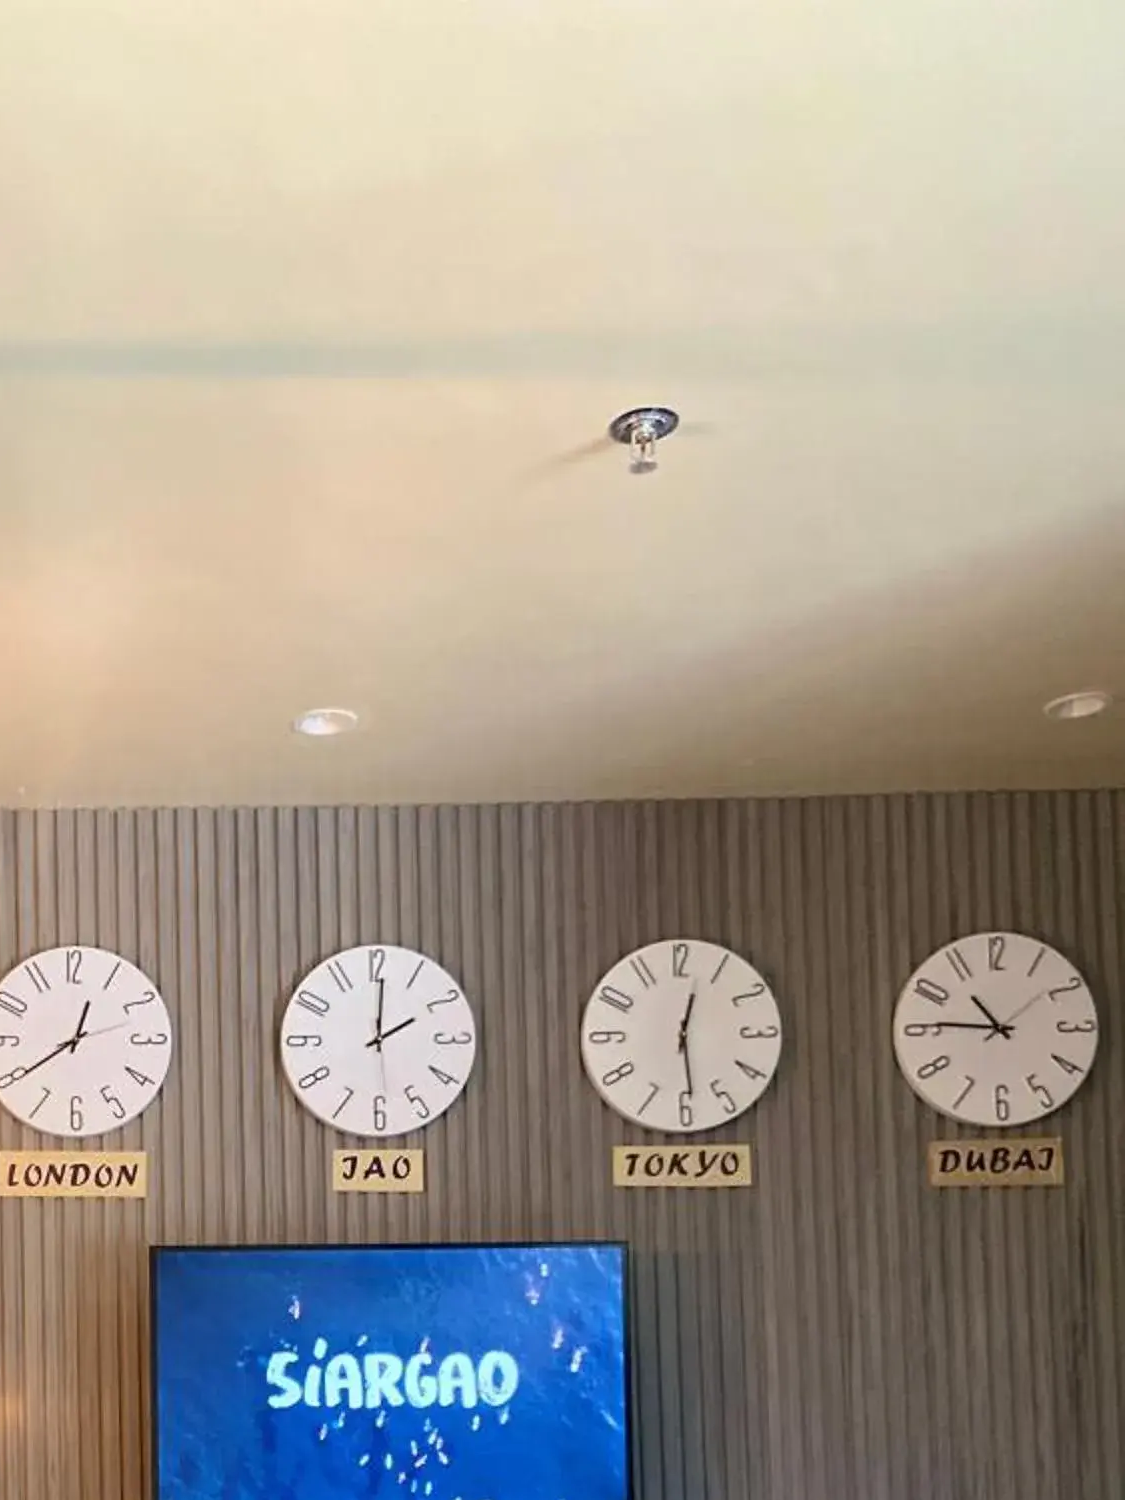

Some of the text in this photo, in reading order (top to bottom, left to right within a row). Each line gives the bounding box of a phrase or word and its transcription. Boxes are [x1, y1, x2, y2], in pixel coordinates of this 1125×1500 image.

[66, 950, 82, 984] 12
[369, 949, 385, 982] 12
[673, 944, 689, 977] 12
[946, 948, 973, 982] 11
[988, 936, 1005, 971] 12
[24, 961, 51, 993] 11
[327, 961, 353, 992] 11
[630, 955, 656, 989] 11
[427, 989, 459, 1013] 2
[599, 986, 634, 1014] 10
[732, 983, 765, 1007] 2
[914, 978, 949, 1006] 10
[1049, 977, 1081, 1001] 2
[123, 992, 155, 1015] 2
[296, 990, 330, 1017] 10
[130, 1033, 167, 1044] 3
[434, 1032, 471, 1044] 3
[589, 1031, 625, 1044] 9
[740, 1026, 778, 1038] 3
[904, 1024, 941, 1037] 9
[1057, 1020, 1095, 1033] 3
[287, 1035, 321, 1047] 9
[125, 1066, 155, 1086] 4
[299, 1066, 330, 1088] 8
[428, 1065, 460, 1085] 4
[603, 1062, 634, 1086] 8
[735, 1060, 767, 1080] 4
[918, 1055, 950, 1079] 8
[1051, 1053, 1084, 1074] 4
[29, 1087, 50, 1119] 7
[100, 1085, 125, 1119] 5
[332, 1087, 354, 1119] 7
[404, 1085, 430, 1119] 5
[637, 1082, 659, 1116] 7
[710, 1080, 736, 1114] 5
[952, 1075, 975, 1110] 7
[995, 1084, 1009, 1121] 6
[1027, 1073, 1053, 1108] 5
[71, 1096, 82, 1130] 6
[374, 1096, 386, 1131] 6
[679, 1091, 692, 1126] 6
[7, 1163, 139, 1188] LONDON
[625, 1150, 740, 1178] TOKYO
